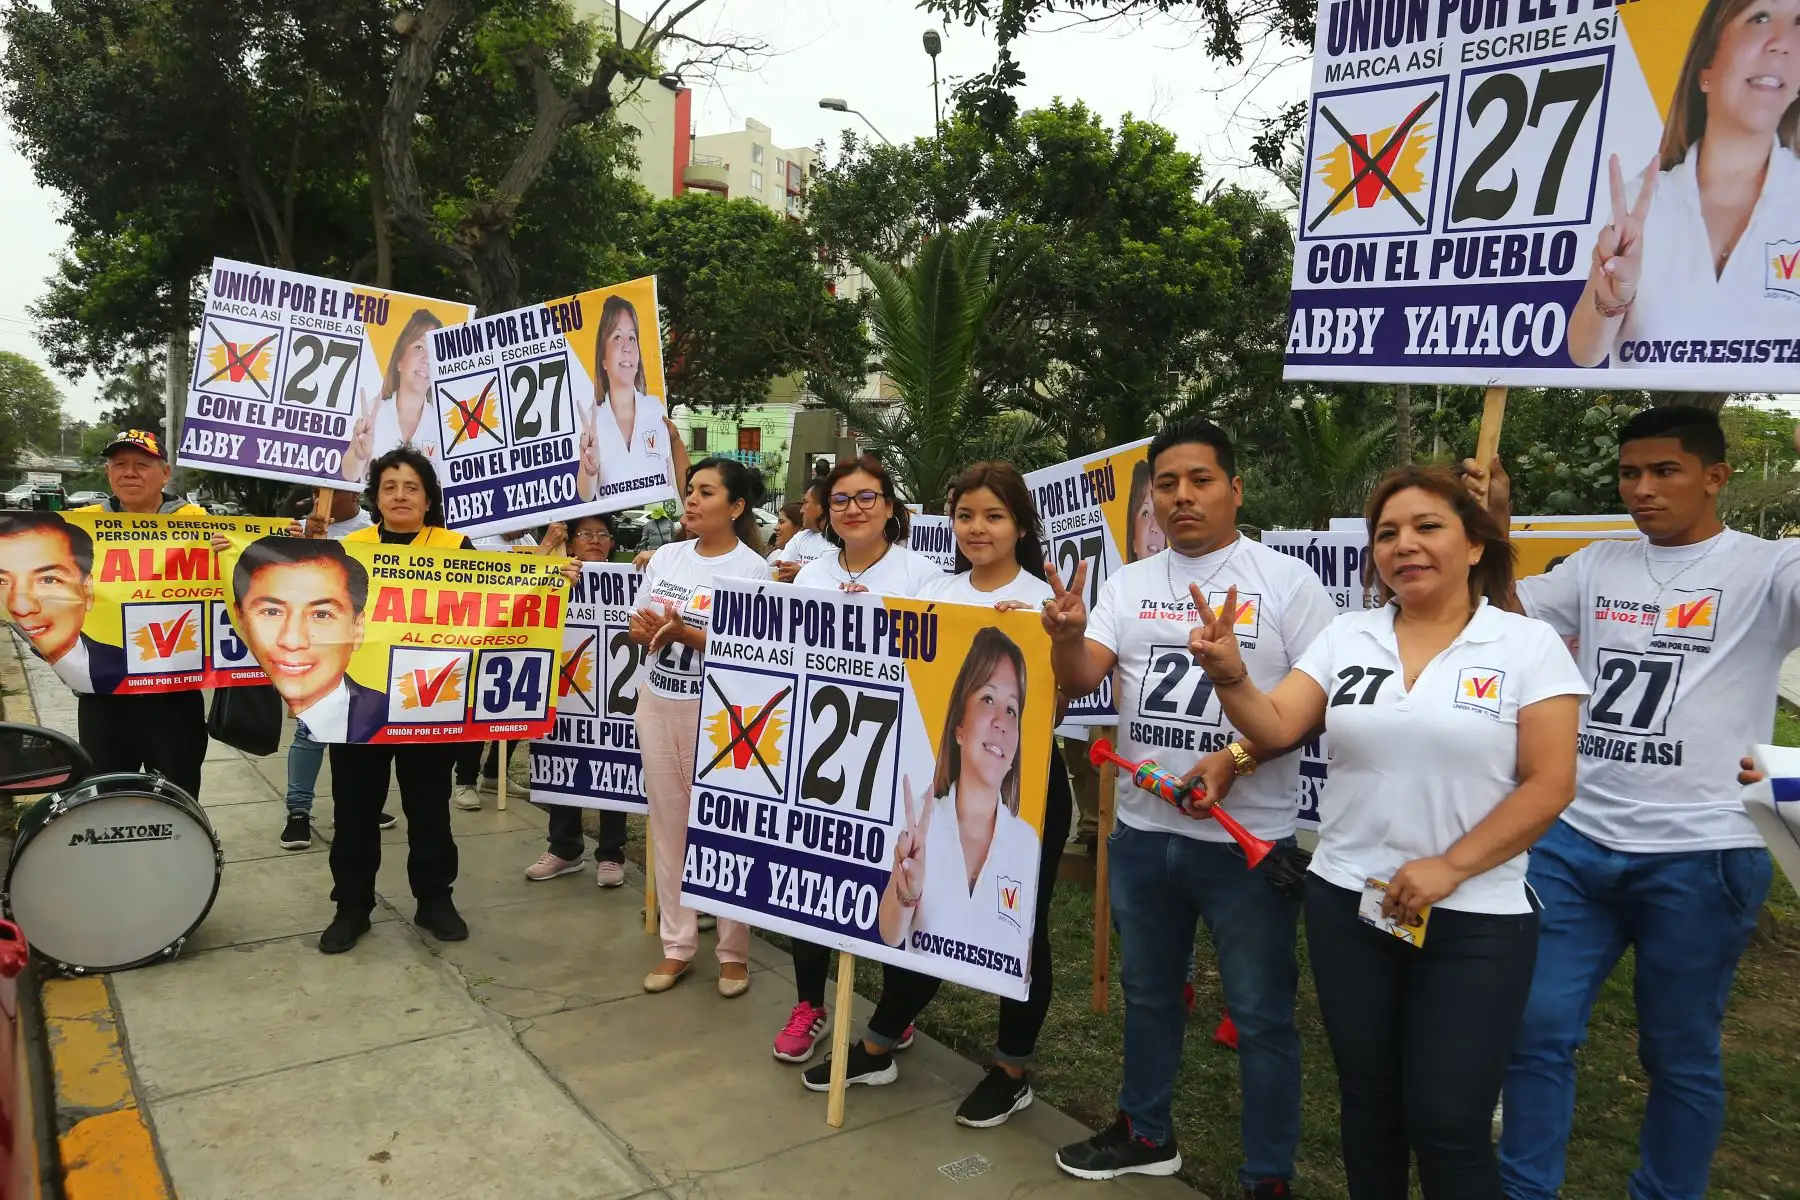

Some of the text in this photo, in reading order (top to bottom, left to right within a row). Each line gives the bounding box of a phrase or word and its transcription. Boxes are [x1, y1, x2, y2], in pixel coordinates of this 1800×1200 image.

[1461, 26, 1567, 63] ESCRIBE
[1573, 10, 1620, 45] ASÍ
[1325, 43, 1443, 83] MARCA ASÍ
[1451, 63, 1605, 223] 27
[1306, 231, 1578, 284] CON EL PUEBLO
[212, 301, 281, 322] MARCA ASÍ
[214, 269, 390, 326] UNIÓN POR EL PERÚ
[291, 315, 364, 335] ESCRIBE ASÍ
[434, 295, 583, 361] UNIÓN POR EL PERÚ
[1286, 302, 1566, 357] ABBY YATACO
[438, 352, 494, 375] MARCA ASÍ
[502, 337, 566, 361] ESCRIBE ASÍ
[284, 335, 358, 408] 27
[510, 359, 567, 440] 27
[197, 396, 346, 437] CON EL PUEBLO
[179, 428, 341, 474] ABBY YATACO
[450, 438, 573, 482] CON EL PUEBLO
[446, 472, 576, 523] ABBY YATACO
[599, 473, 667, 496] CONGRESISTA
[1039, 481, 1064, 519] POR
[1065, 477, 1080, 512] EL
[1080, 458, 1115, 508] PERÚ
[95, 520, 123, 529] POR
[132, 520, 158, 529] LOS
[168, 520, 236, 531] DERECHOS
[245, 524, 261, 534] DE
[1052, 506, 1103, 533] ESCRIBE ASÍ
[96, 531, 167, 541] PERSONAS
[172, 531, 199, 540] CON
[912, 522, 952, 553] UNIÓN
[373, 554, 561, 575] POR LOS DERECHOS DE LA
[943, 557, 955, 567] AS
[373, 568, 442, 581] PERSONAS
[446, 572, 473, 584] CON
[477, 574, 565, 587] DISCAPACIDAD
[589, 572, 625, 606] POR
[131, 588, 224, 599] AL CONGR
[371, 586, 560, 629] ALMERÍ
[1141, 599, 1157, 609] Tu
[1614, 600, 1639, 611] voz
[1642, 604, 1661, 613] es
[577, 607, 595, 620] ASÍ
[713, 586, 938, 663] UNIÓN POR EL PERÚ
[1139, 609, 1156, 620] mi
[1160, 611, 1184, 621] voz
[1612, 611, 1637, 623] voz
[400, 632, 528, 645] AL CONGRESO
[711, 640, 794, 666] MARCA ASÍ
[1240, 641, 1256, 649] PERÚ
[1668, 641, 1682, 650] POR
[129, 678, 153, 687] UNIÓN
[156, 677, 171, 685] POR
[608, 631, 647, 716] 2
[806, 653, 905, 682] ESCRIBE ASÍ
[483, 656, 542, 714] 34
[1330, 665, 1394, 708] 27
[1591, 657, 1673, 729] 27
[387, 727, 413, 736] UNIÓN
[443, 726, 463, 735] PERÚ
[489, 724, 528, 732] CONGRESO
[577, 719, 595, 744] EL
[1130, 722, 1195, 751] ESCRIBE
[801, 686, 899, 811] 27
[1641, 740, 1684, 767] ASÍ
[530, 754, 578, 787] ABBY
[697, 792, 884, 863] CON EL PUEBLO
[682, 844, 879, 931] ABBY YATACO
[912, 931, 1023, 978] CONGRESISTA
